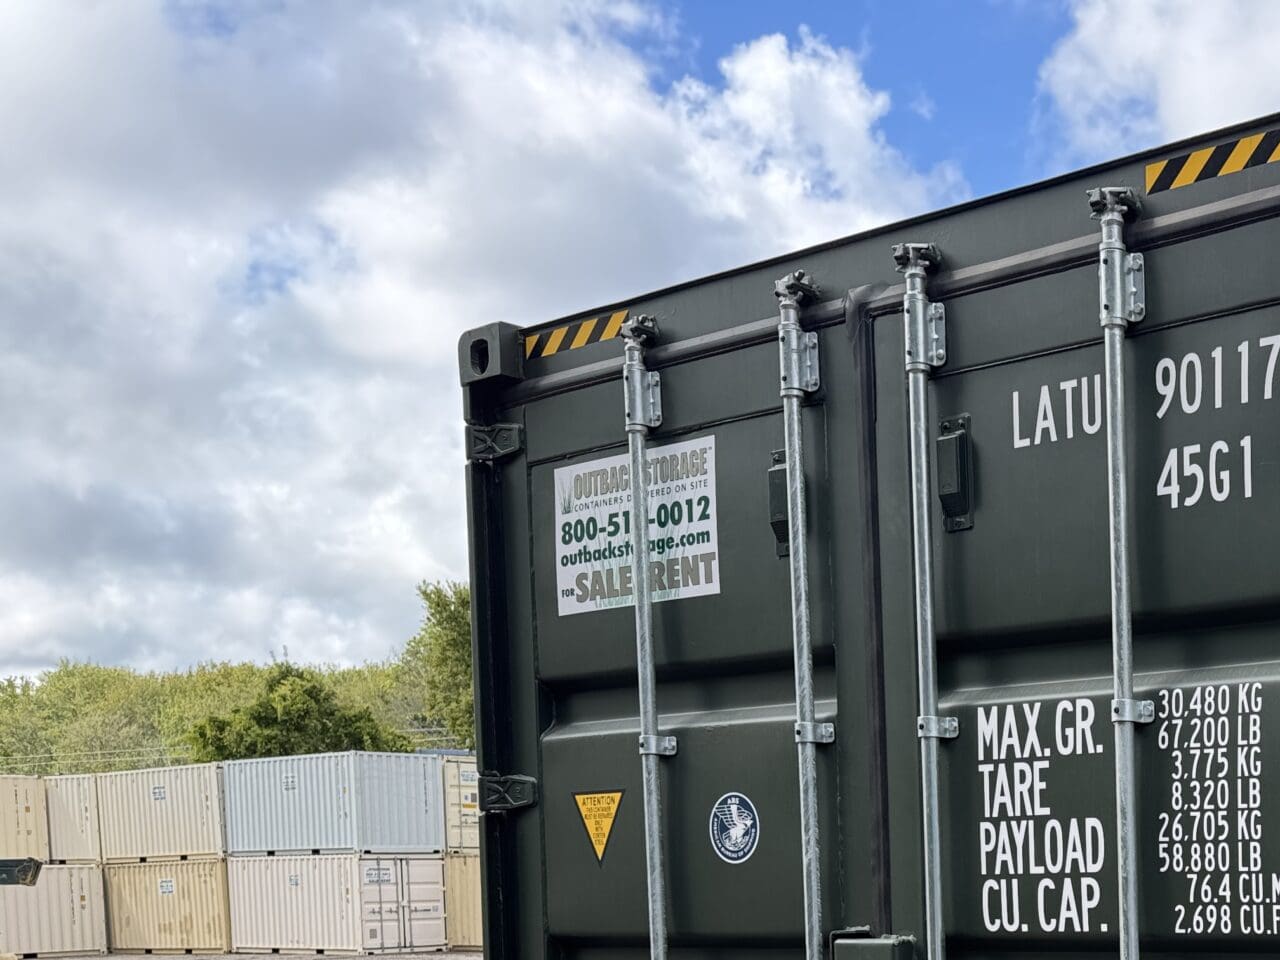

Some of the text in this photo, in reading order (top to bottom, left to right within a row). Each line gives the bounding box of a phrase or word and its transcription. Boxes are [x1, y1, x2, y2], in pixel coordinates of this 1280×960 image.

[1012, 373, 1102, 449] LATU
[574, 463, 632, 500] OUTBAC
[1156, 435, 1253, 509] 45G1
[574, 496, 624, 513] CONTAINERS
[675, 483, 687, 493] ON
[690, 479, 709, 490] SITE
[561, 495, 711, 546] 800-51-0012
[561, 530, 711, 568] outbackstage.com
[562, 551, 717, 604] FOR SALE RENT
[1158, 682, 1263, 719] 30,480 KG
[977, 698, 1104, 761] MAX. GR.
[1158, 714, 1261, 749] 67,200 LB
[1171, 746, 1262, 780] 3,775 KG
[978, 760, 1051, 818] TARE
[1171, 778, 1262, 811] 8,320 LB
[1158, 809, 1262, 842] 26,705 KG
[979, 817, 1105, 875] PAYLOAD
[1158, 842, 1262, 873] 58,880 LB
[982, 877, 1108, 933] CU. CAP.
[1187, 873, 1231, 904] 76.4
[1174, 904, 1232, 935] 2,698
